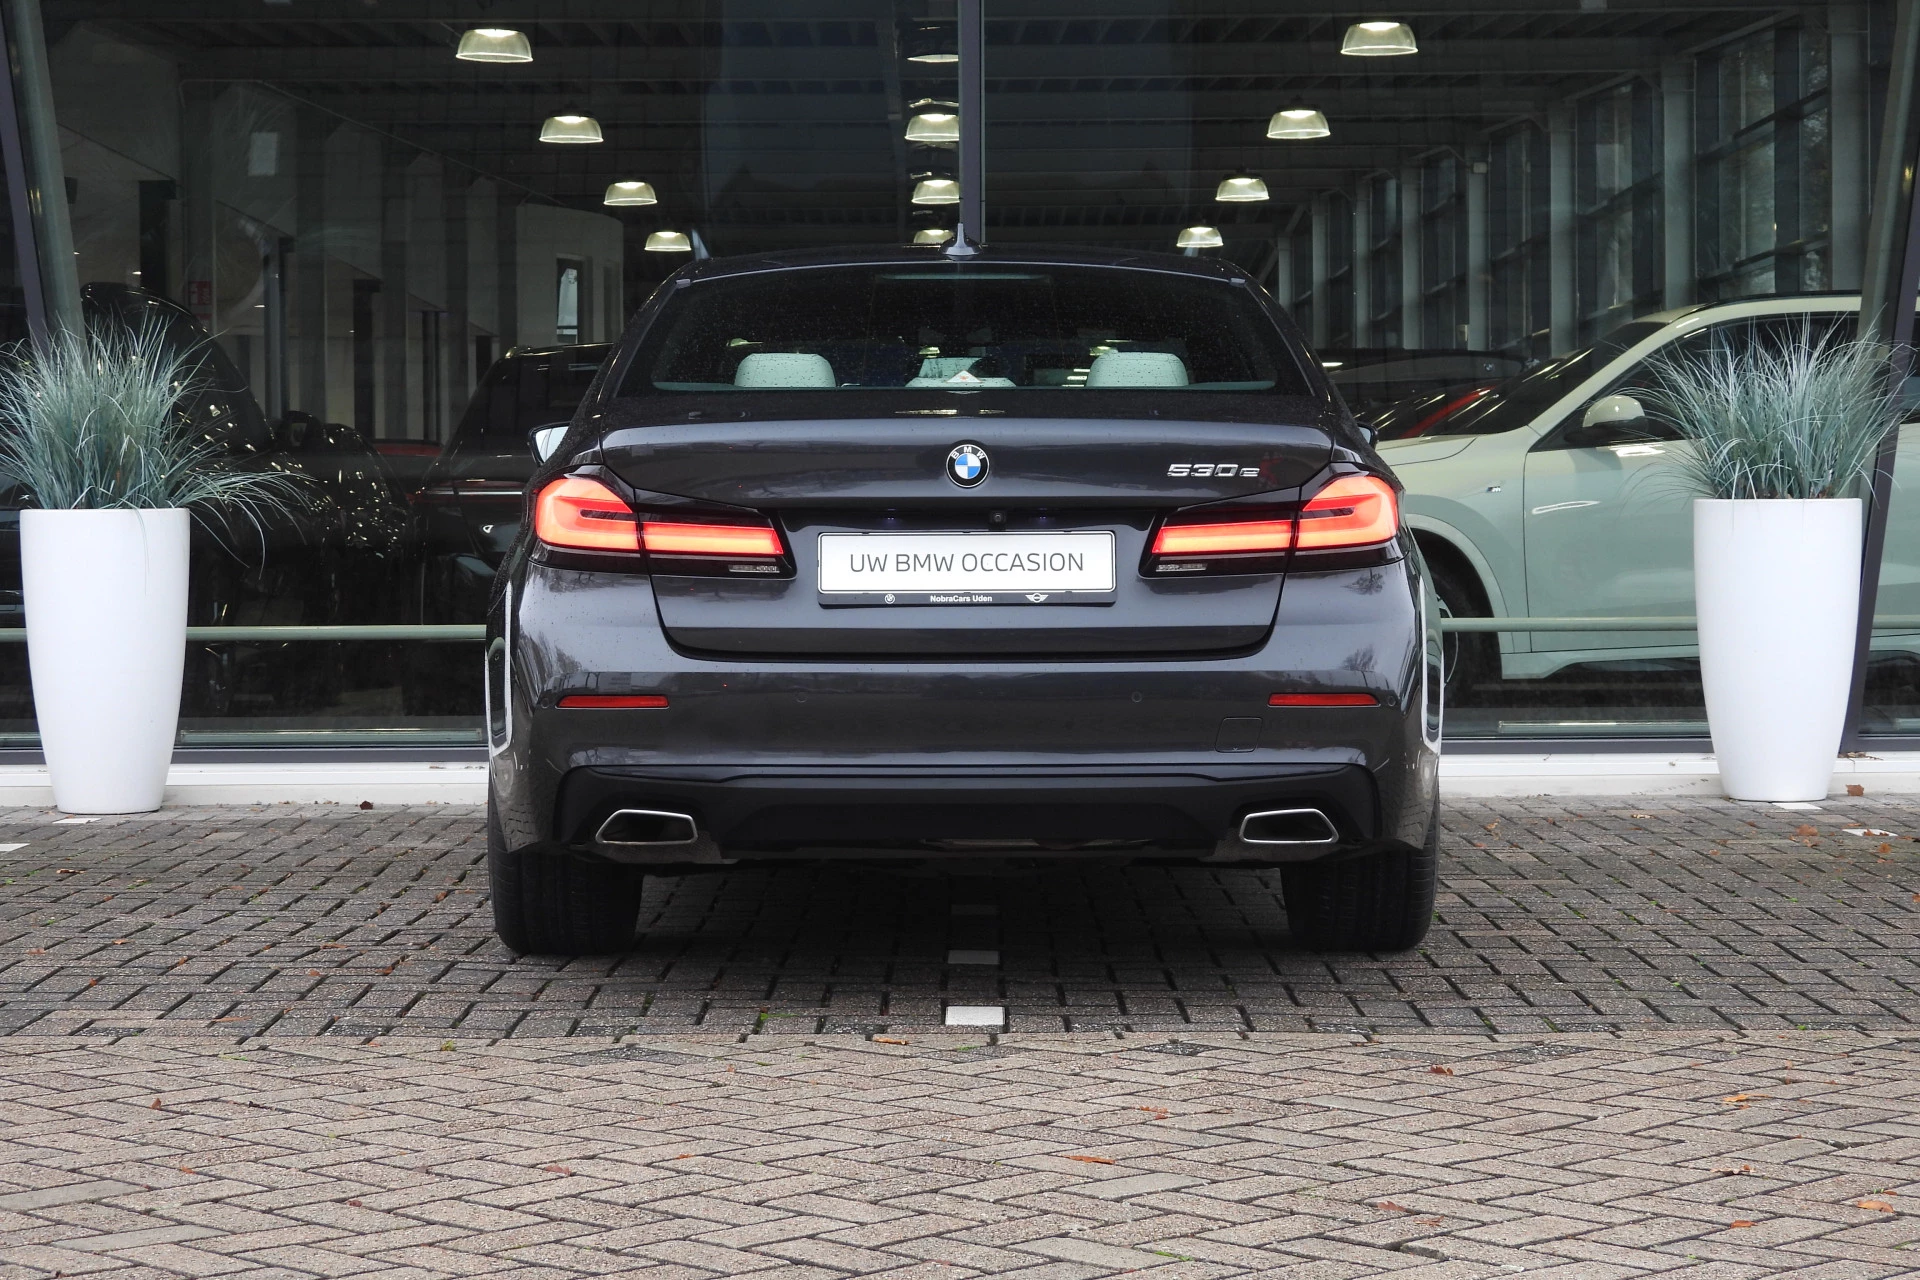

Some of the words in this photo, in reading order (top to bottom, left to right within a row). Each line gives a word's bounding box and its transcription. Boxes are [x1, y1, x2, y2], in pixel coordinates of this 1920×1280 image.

[950, 446, 986, 460] BMW
[1167, 464, 1260, 477] 530e
[851, 553, 888, 573] UW
[896, 553, 954, 573] BMW
[962, 552, 1084, 572] OCCASION
[972, 594, 993, 602] Uden
